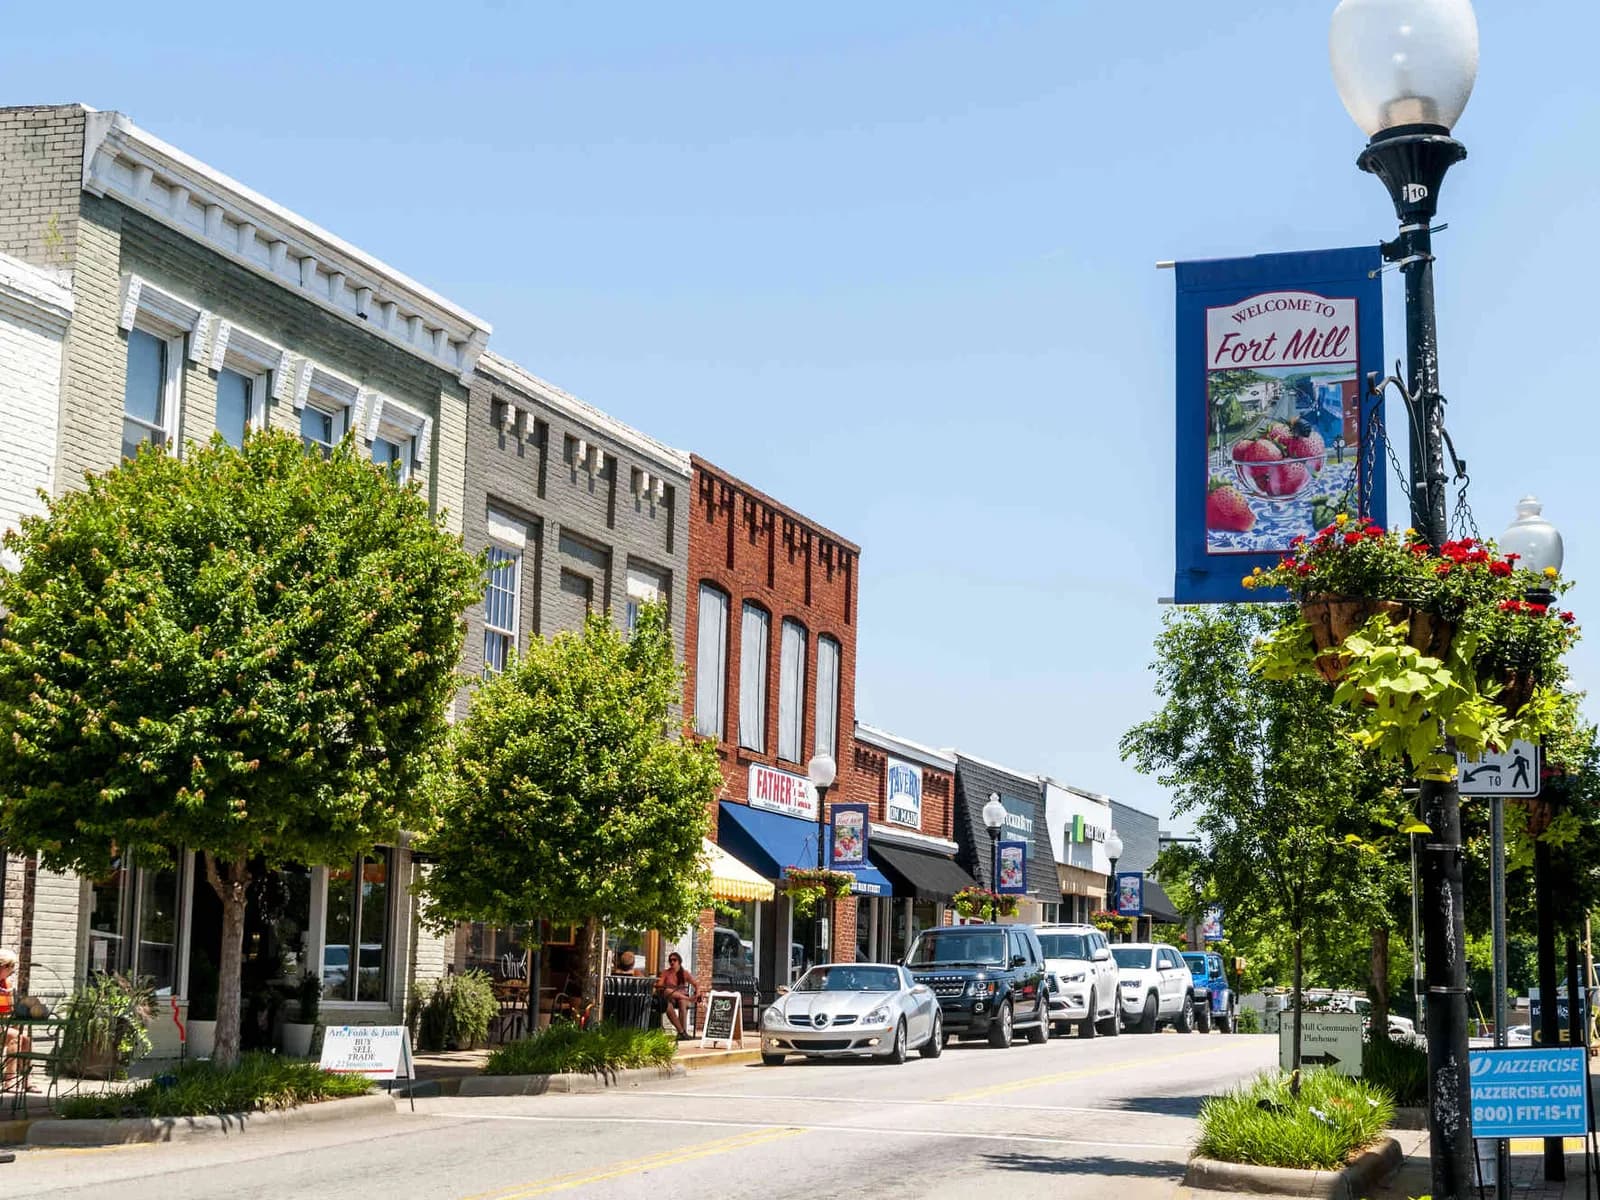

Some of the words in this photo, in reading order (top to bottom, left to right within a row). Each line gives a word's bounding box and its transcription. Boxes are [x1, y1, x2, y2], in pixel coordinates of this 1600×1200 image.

[1231, 298, 1312, 324] WELCOME
[1315, 301, 1336, 318] TO
[1214, 331, 1278, 365] Fort
[1282, 325, 1351, 361] Mill
[1460, 752, 1487, 763] HE
[889, 765, 920, 809] TAVERN
[1489, 775, 1502, 787] TO
[1316, 1023, 1359, 1033] Community
[354, 1038, 372, 1046] BUY
[1303, 1033, 1338, 1043] Playhouse
[347, 1053, 375, 1061] TRADE
[1493, 1058, 1580, 1074] JAZZERCISE
[1474, 1105, 1512, 1124] 800)
[1516, 1104, 1582, 1121] FIT-IS-IT
